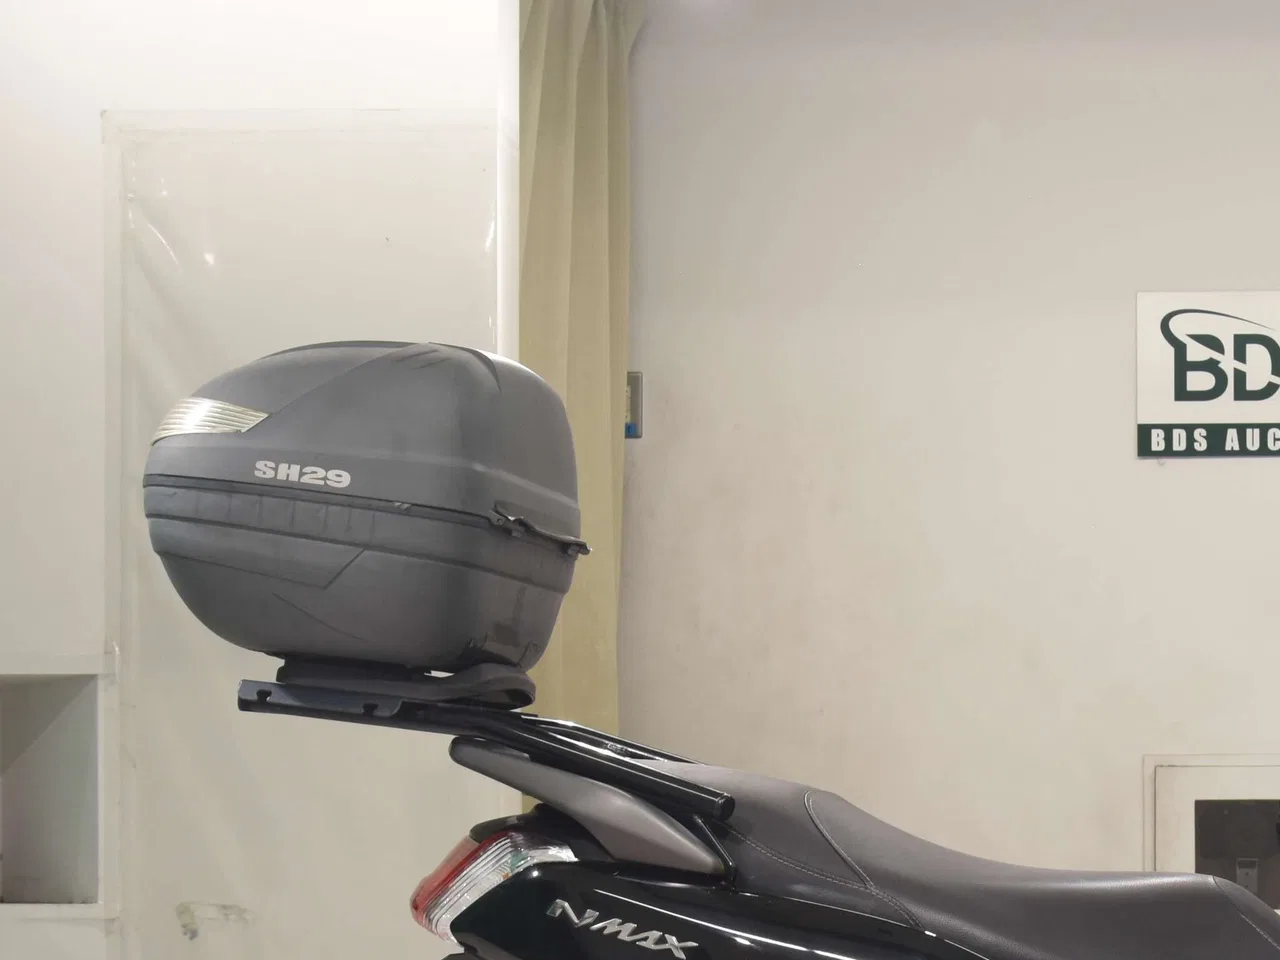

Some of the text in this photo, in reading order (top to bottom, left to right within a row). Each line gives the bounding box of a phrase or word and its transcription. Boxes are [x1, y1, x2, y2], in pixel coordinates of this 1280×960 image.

[1150, 428, 1208, 452] BDS
[254, 460, 351, 488] SH29
[546, 898, 699, 960] NMAX
